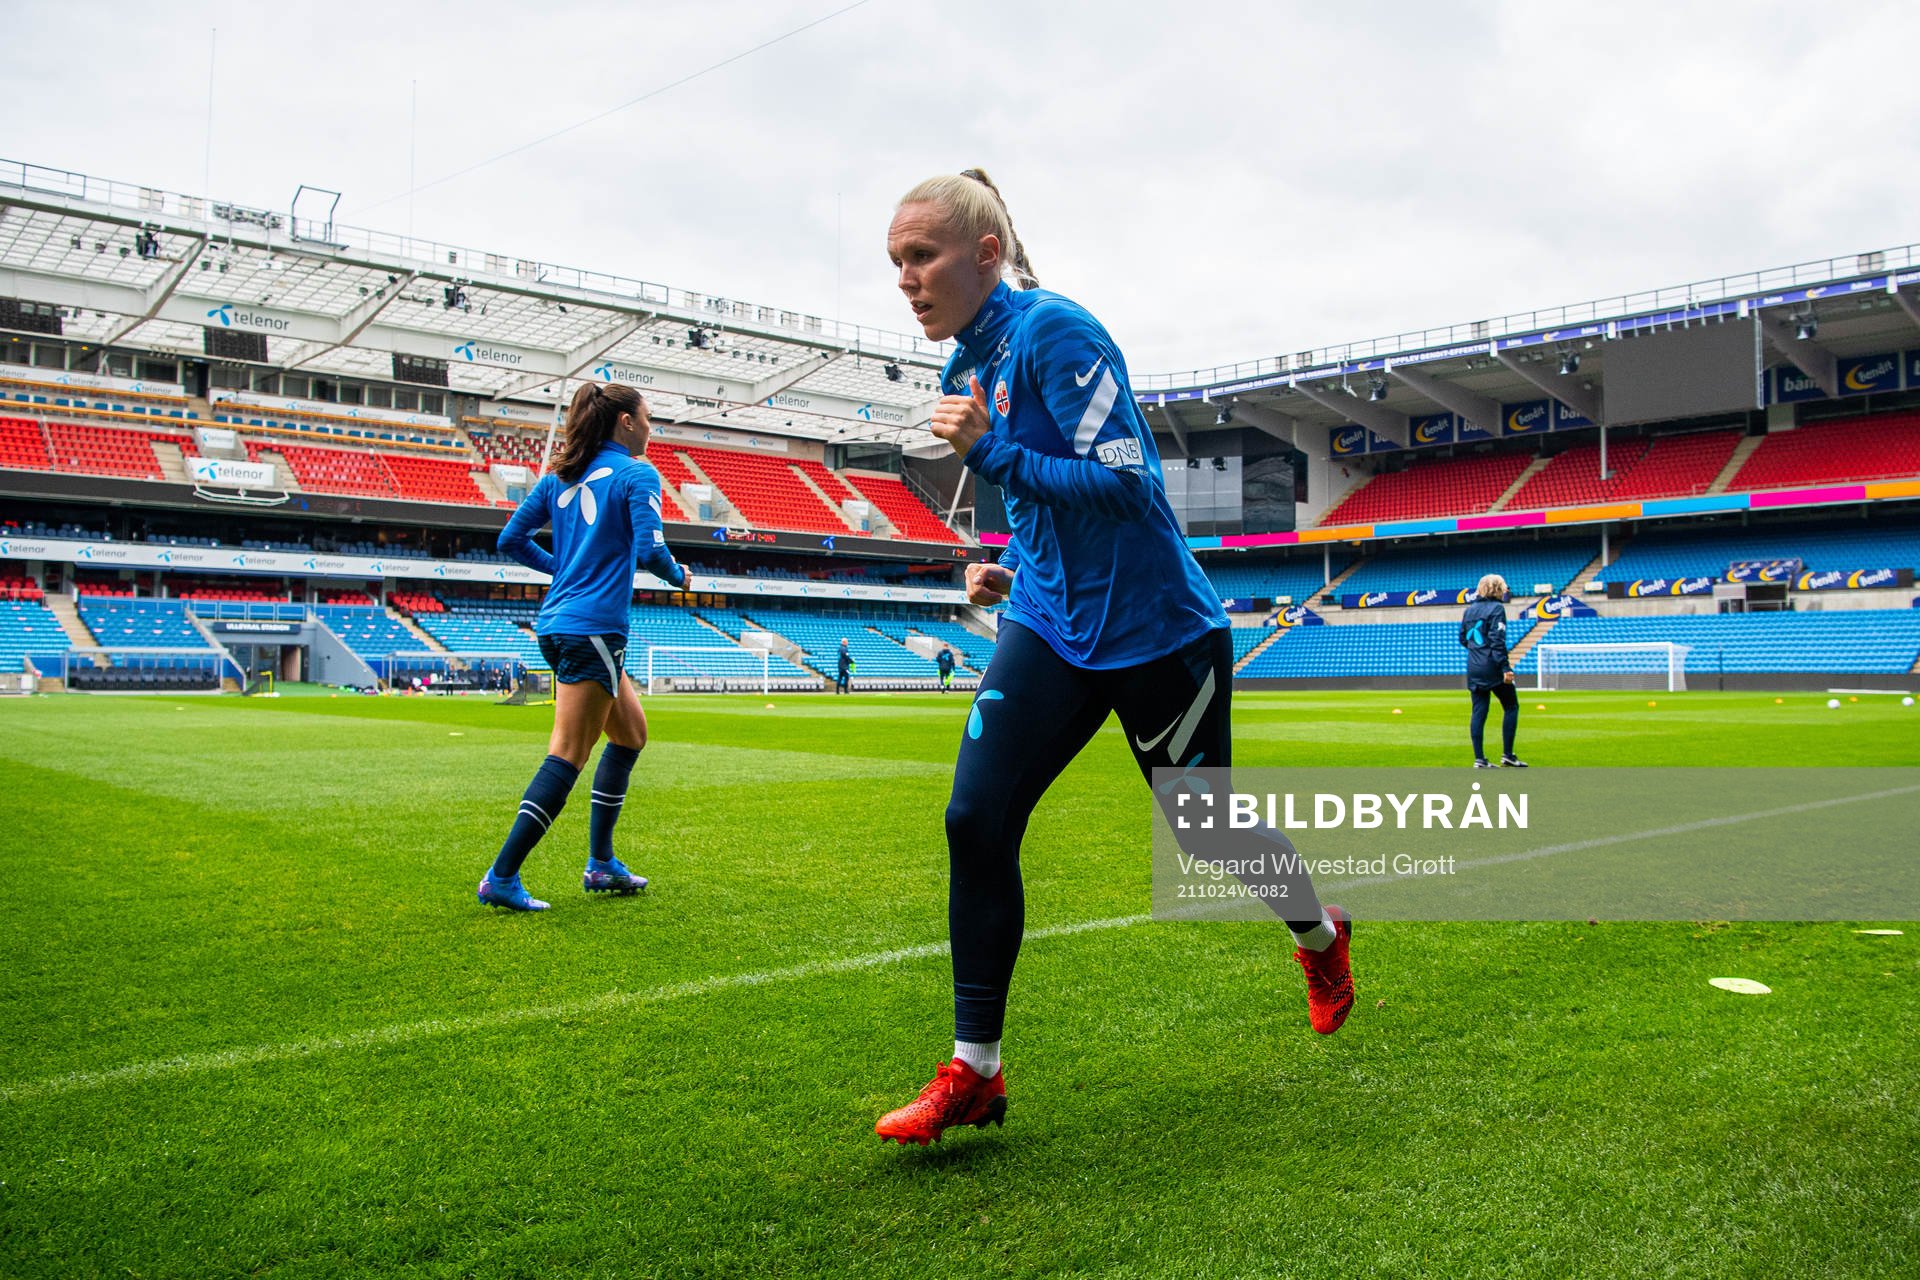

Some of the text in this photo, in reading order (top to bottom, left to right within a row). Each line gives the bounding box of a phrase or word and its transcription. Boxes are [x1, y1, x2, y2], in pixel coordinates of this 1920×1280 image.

[234, 311, 290, 331] telenor
[476, 348, 522, 364] telenor
[613, 368, 654, 385] telenor
[1858, 360, 1895, 382] Bendit
[775, 394, 810, 408] telenor
[872, 408, 904, 421] telenor
[1424, 418, 1449, 436] Bendit
[218, 467, 263, 480] telenor
[9, 544, 46, 554] telenor
[93, 548, 127, 558] telenor
[171, 552, 204, 562] telenor
[245, 556, 276, 566] telenor
[315, 559, 345, 569] telenor
[382, 563, 410, 572] telenor
[444, 566, 472, 575] telenor
[505, 569, 530, 577] telenor
[1810, 571, 1842, 589] Bendit
[1859, 568, 1893, 588] Bendit
[1638, 579, 1666, 595] Bendit
[1681, 577, 1709, 594] Bendit
[1414, 589, 1438, 604] Bendit
[1545, 595, 1573, 613] Bendit
